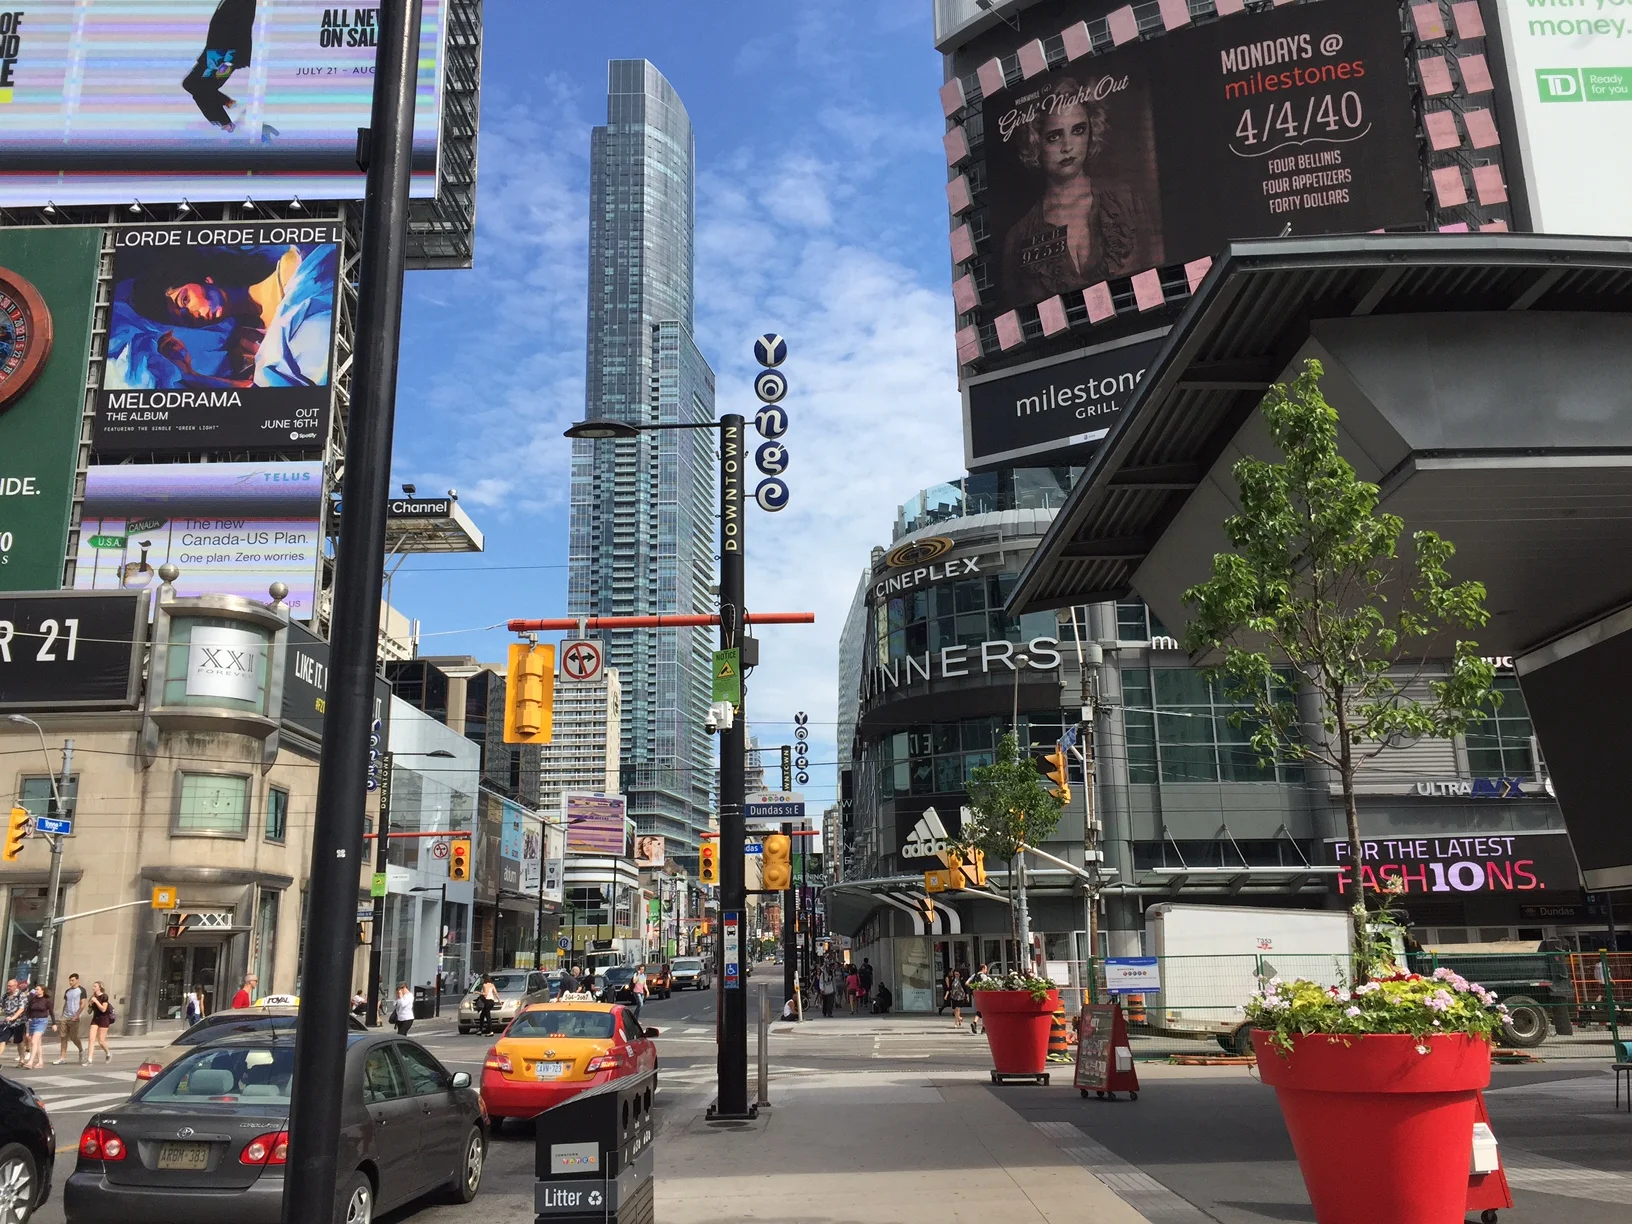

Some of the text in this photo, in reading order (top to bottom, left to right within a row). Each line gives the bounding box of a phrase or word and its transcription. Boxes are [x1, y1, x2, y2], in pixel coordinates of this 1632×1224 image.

[321, 8, 380, 28] ALL NE
[320, 28, 378, 48] ON SAL
[1528, 18, 1632, 39] money.
[1220, 33, 1344, 75] MONDAYS @
[296, 67, 322, 76] JULY
[327, 67, 337, 75] 21
[1225, 60, 1365, 100] milestones
[1590, 74, 1623, 84] Ready
[1041, 86, 1092, 116] Night
[1093, 74, 1130, 101] Out
[1540, 75, 1577, 96] TD
[1592, 84, 1628, 95] for you
[1235, 90, 1362, 145] 4/4/40
[1268, 150, 1342, 175] FOUR BELLINIS
[1262, 168, 1352, 195] FOUR APPETIZERS
[1269, 188, 1350, 214] FORTY DOLLARS
[116, 231, 182, 247] LORDE
[187, 229, 254, 245] LORDE
[259, 227, 327, 244] LORDE
[108, 391, 242, 409] MELODRAMA
[1016, 368, 1146, 417] milestone
[106, 411, 168, 421] THE ALBUM
[295, 408, 320, 418] OUT
[1075, 400, 1119, 419] GRILL
[261, 418, 319, 429] JUNE 16TH
[754, 333, 789, 512] Yonge
[264, 472, 311, 482] TELUS
[725, 426, 738, 551] DOWNTOWN
[392, 501, 447, 513] Channel
[128, 519, 161, 534] CANADA
[184, 518, 245, 530] The new
[181, 531, 309, 547] Canada-US Plan.
[179, 553, 203, 563] One
[206, 552, 231, 566] plan.
[235, 552, 261, 562] Zero
[875, 556, 981, 598] CINEPLEX
[36, 619, 79, 662] 21
[201, 648, 254, 673] XXI
[716, 651, 736, 661] NOTICE
[295, 650, 314, 684] LIKE
[381, 756, 389, 809] DOWNTOWN
[750, 805, 799, 815] Dundas St E
[1335, 837, 1515, 861] FR THE LATEST
[198, 913, 233, 926] XXI
[1540, 907, 1575, 916] Dundas
[188, 1149, 206, 1162] 383
[545, 1188, 583, 1207] Litter
